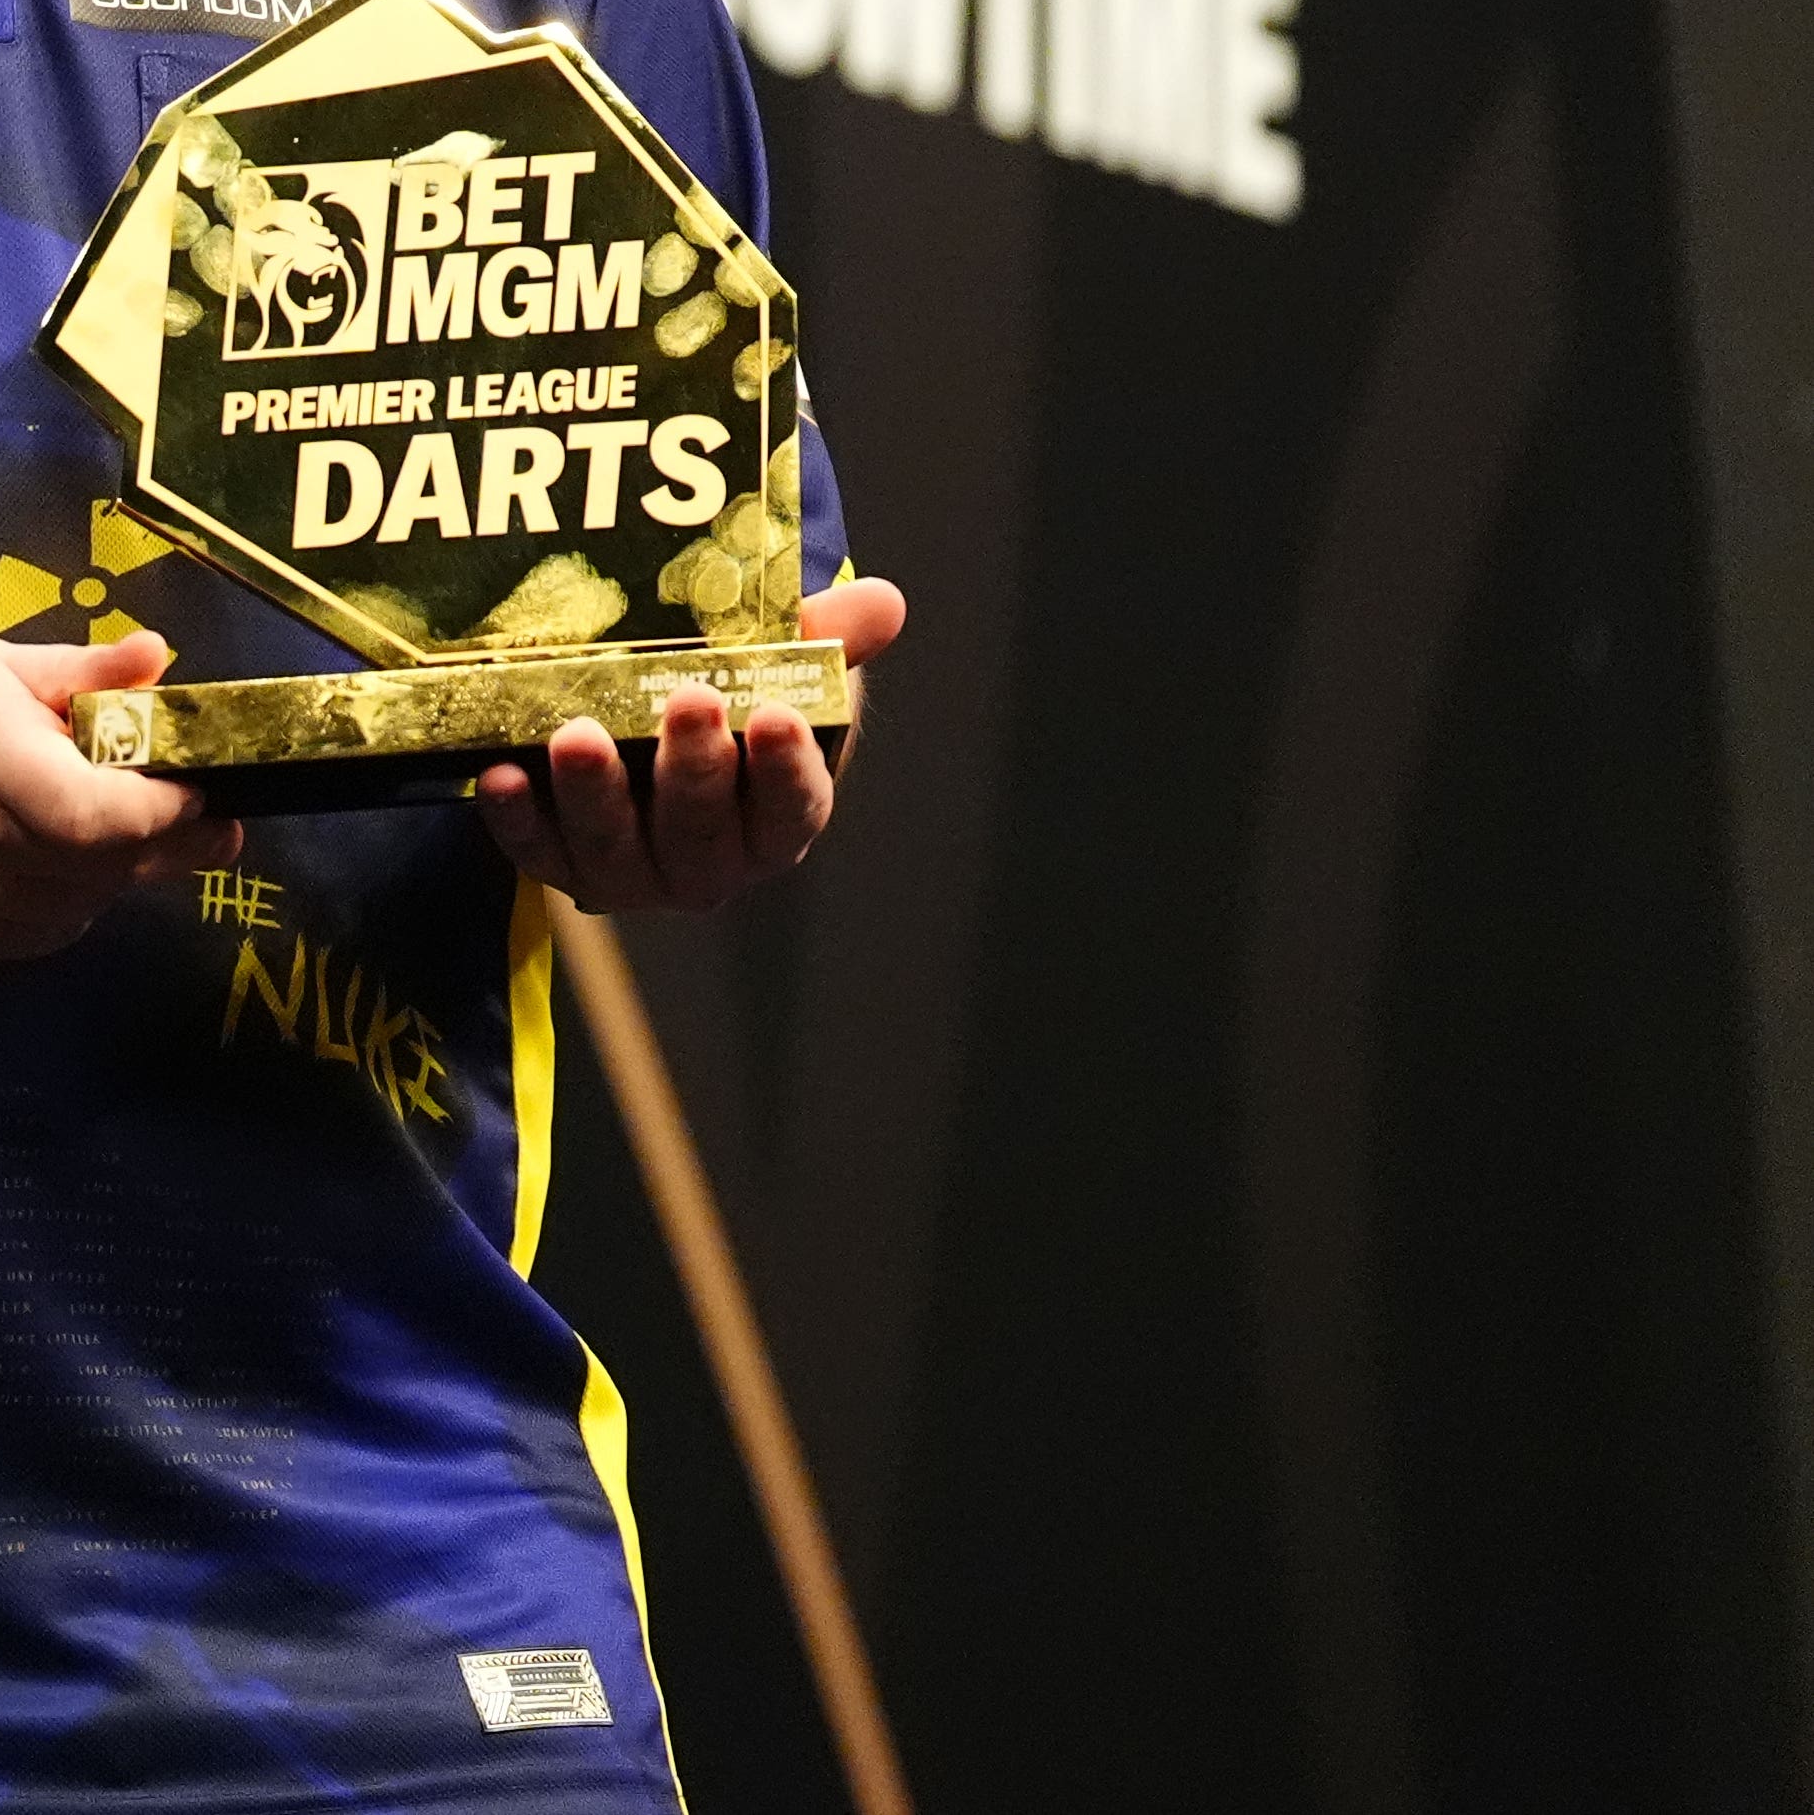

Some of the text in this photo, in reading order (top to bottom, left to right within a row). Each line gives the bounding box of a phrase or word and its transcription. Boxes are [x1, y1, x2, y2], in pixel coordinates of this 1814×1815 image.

[393, 150, 597, 251] BET
[385, 238, 644, 346] MGM
[221, 363, 638, 436] PREMIER LEAGUE
[290, 414, 732, 551] DARTS
[734, 663, 824, 686] WINNER
[192, 866, 286, 930] THE
